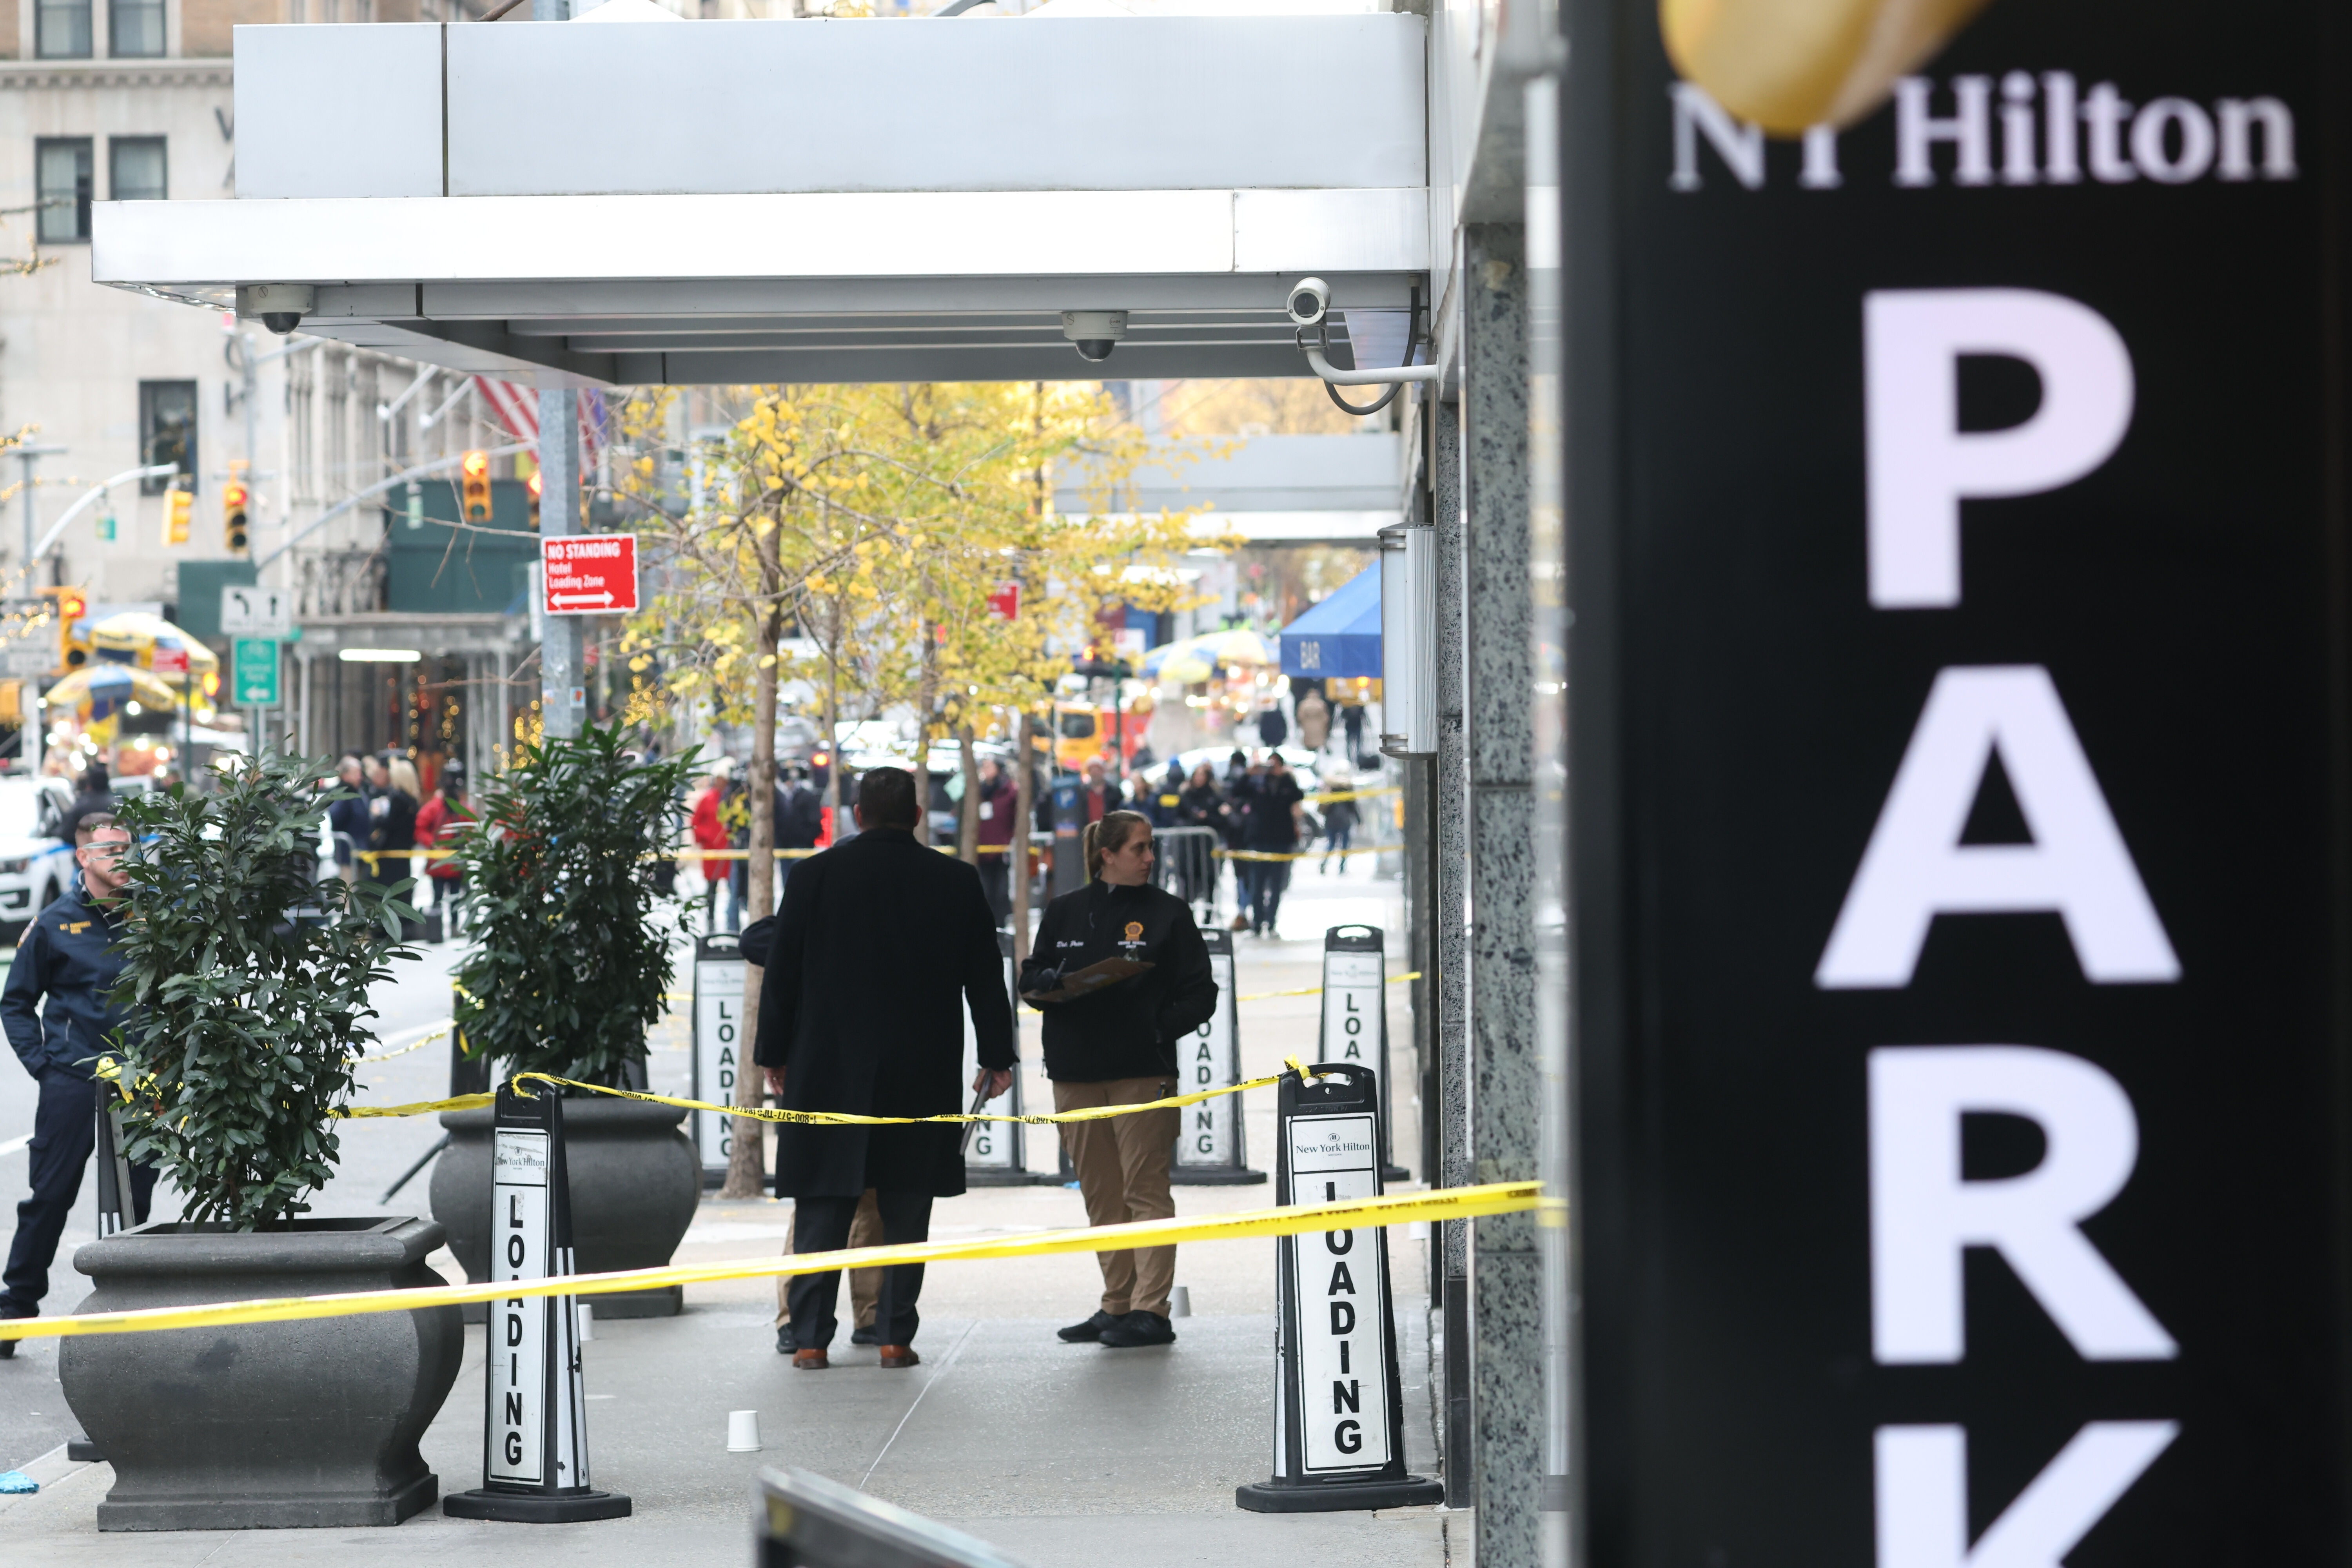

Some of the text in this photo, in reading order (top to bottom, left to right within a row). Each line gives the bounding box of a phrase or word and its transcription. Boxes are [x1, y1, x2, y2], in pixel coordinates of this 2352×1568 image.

[1892, 70, 2299, 188] Hilton
[548, 541, 621, 560] NO STANDING
[548, 561, 572, 575] Hotel
[549, 574, 605, 591] Loading Zone
[1300, 641, 1320, 670] BAR
[1197, 1020, 1212, 1154] OADING
[1296, 1142, 1370, 1154] New York Hilton
[497, 1156, 544, 1167] New York Hilton
